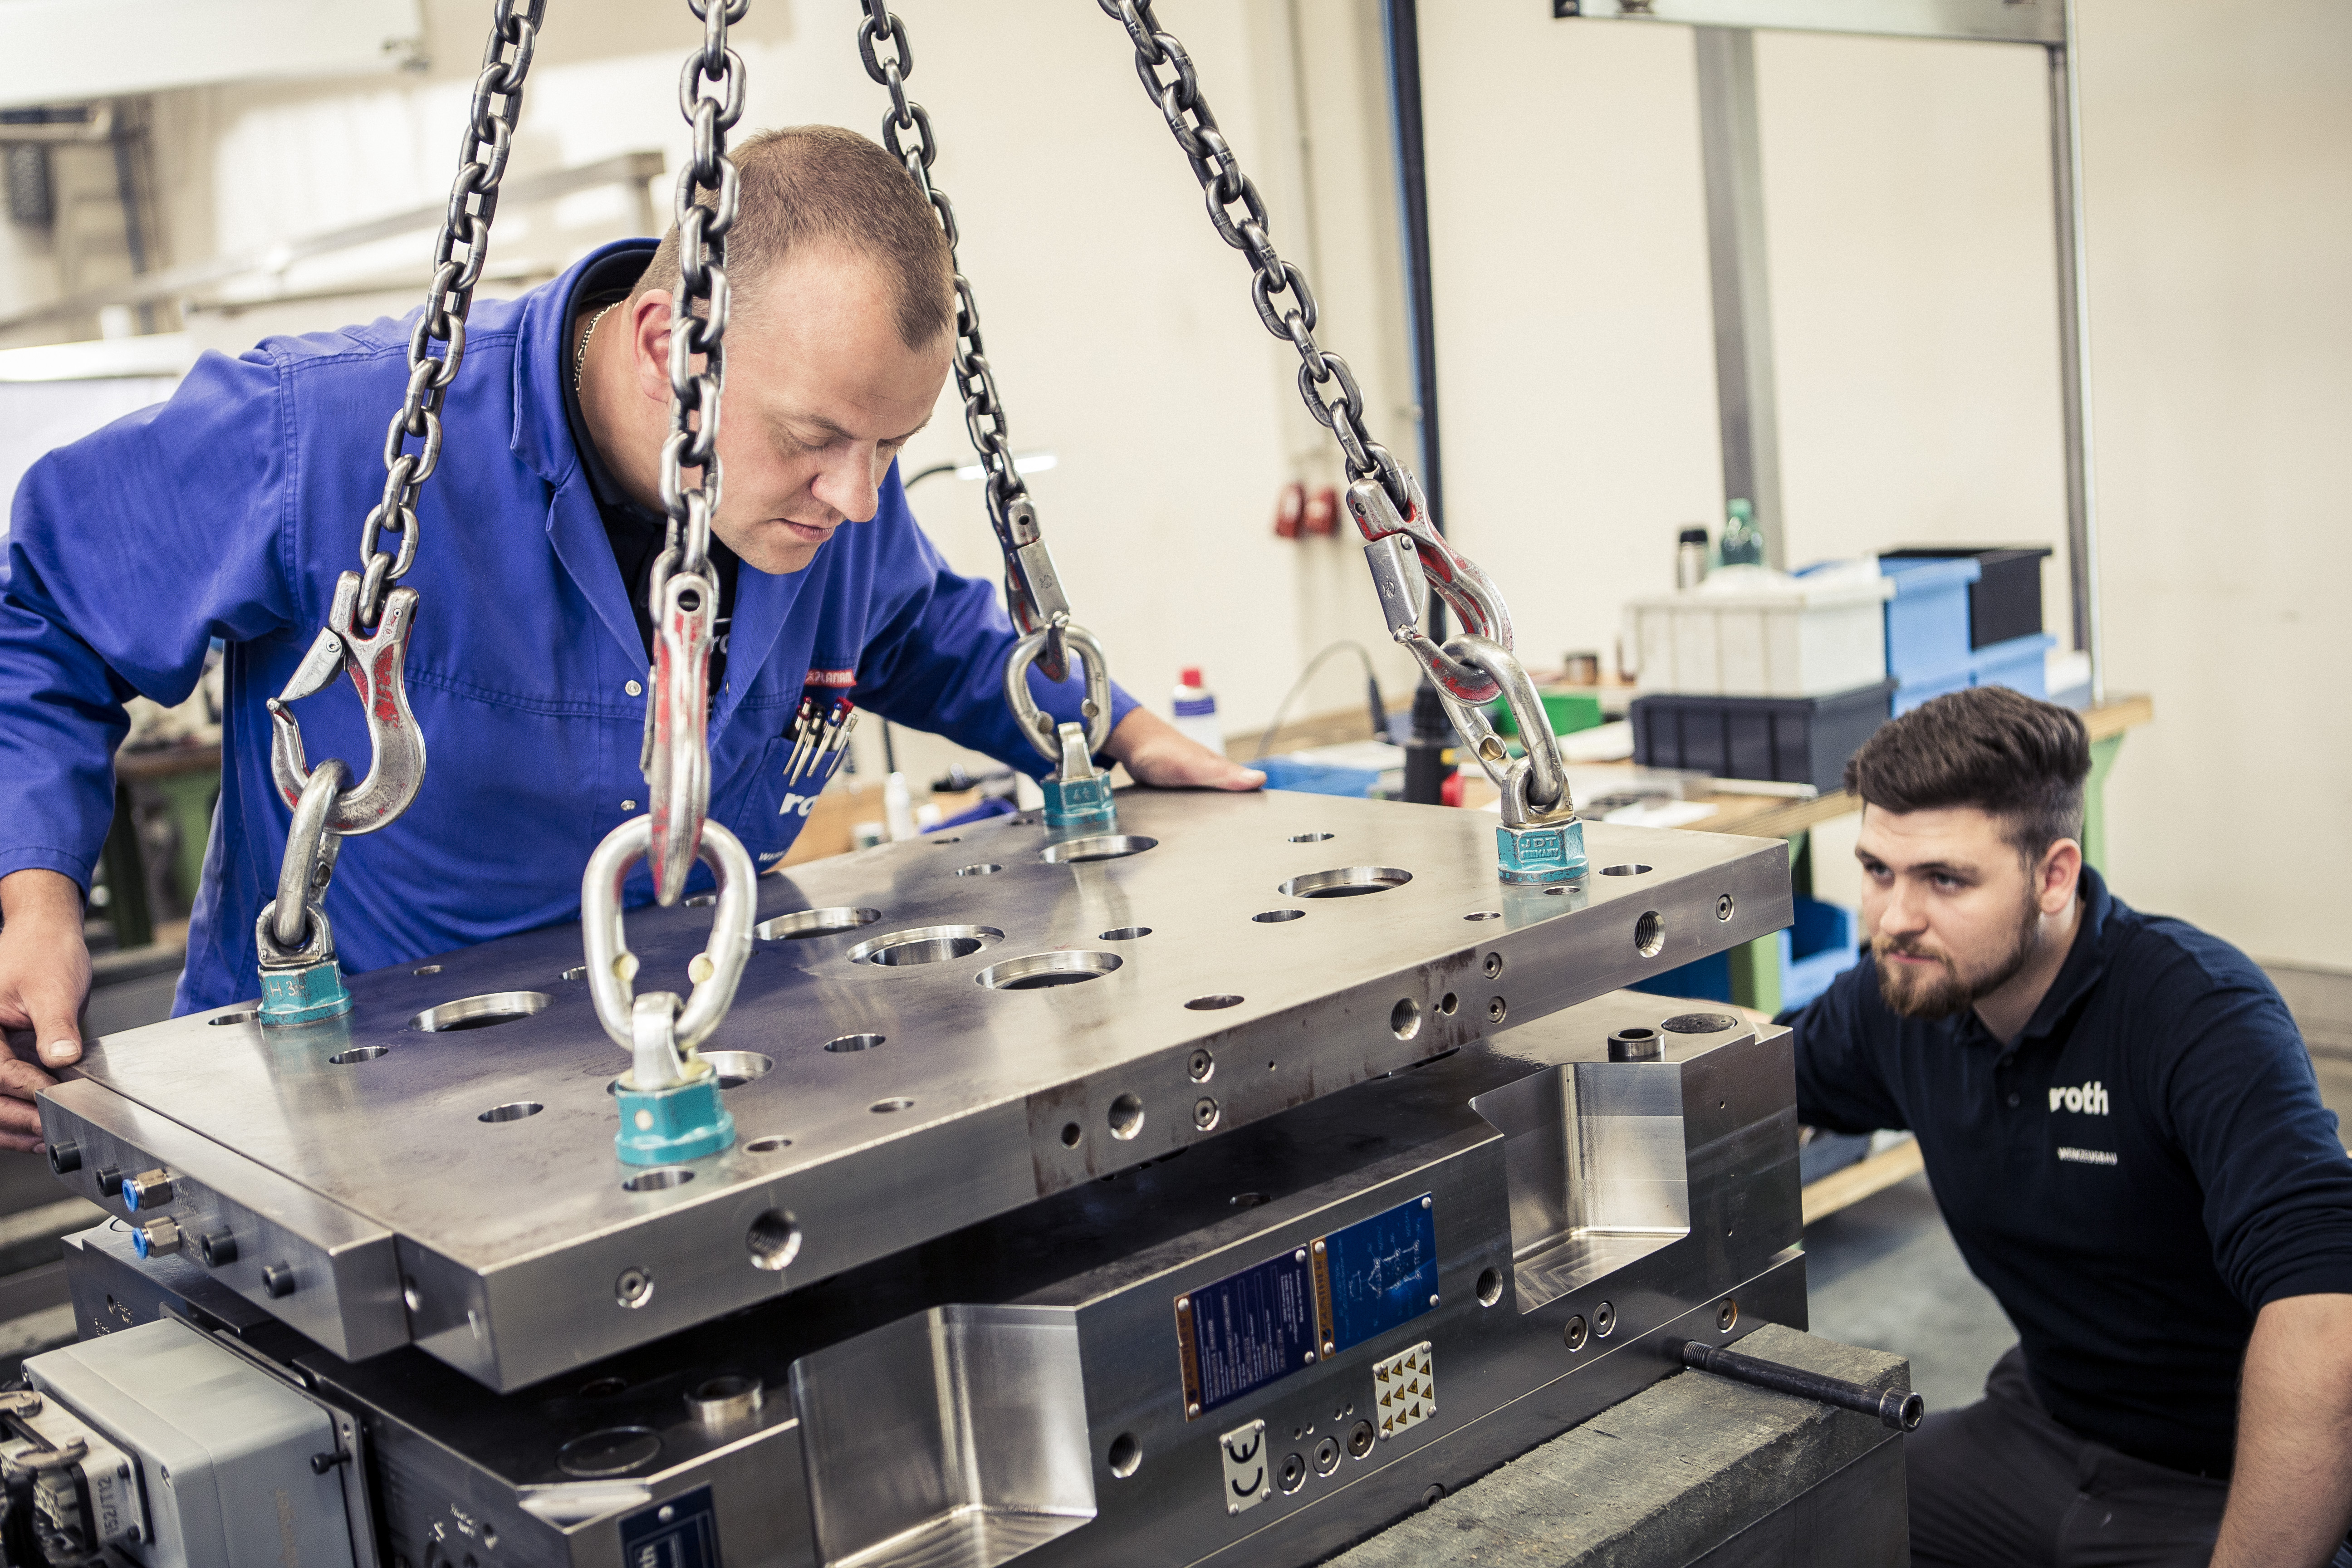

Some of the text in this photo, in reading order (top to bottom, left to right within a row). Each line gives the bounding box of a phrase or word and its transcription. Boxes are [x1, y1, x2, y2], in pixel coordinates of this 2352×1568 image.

[779, 793, 819, 816] ro
[1521, 837, 1557, 848] JDT
[2048, 1081, 2109, 1116] roth
